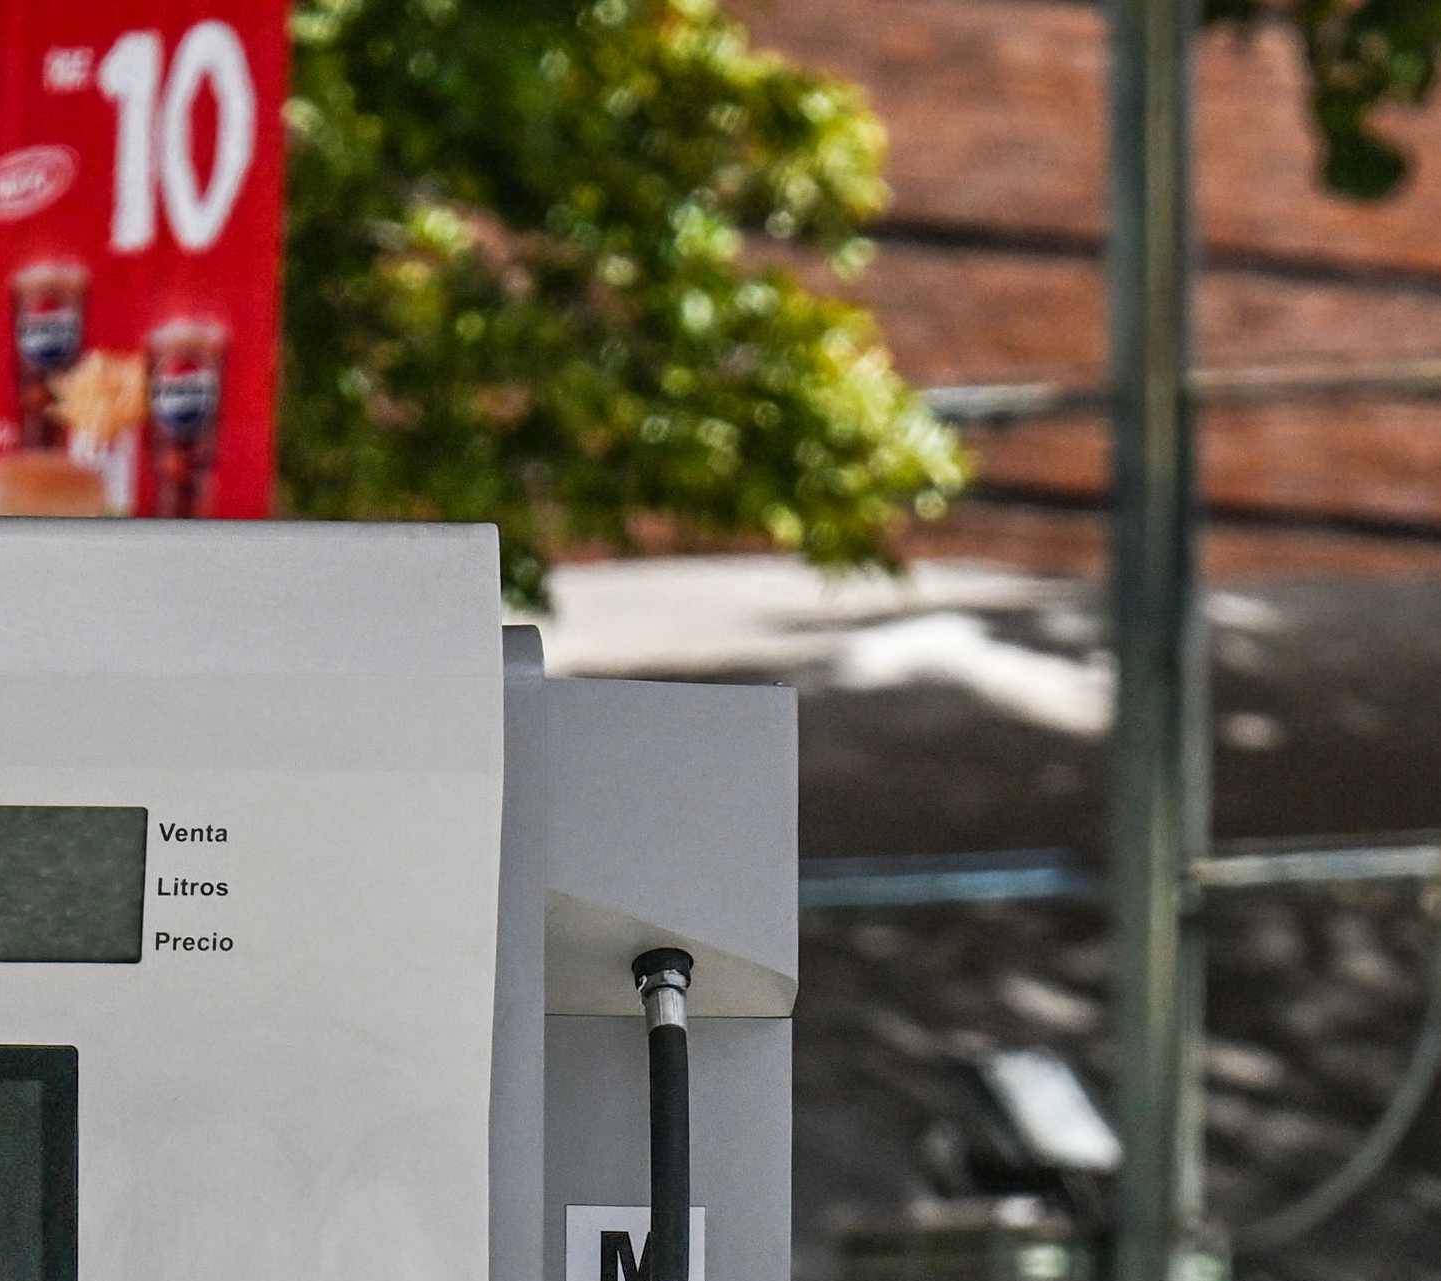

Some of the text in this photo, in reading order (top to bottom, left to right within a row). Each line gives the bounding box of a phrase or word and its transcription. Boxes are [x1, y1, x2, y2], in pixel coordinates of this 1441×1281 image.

[98, 20, 257, 254] 10
[159, 822, 228, 843] Venta
[157, 877, 229, 897] Litros
[155, 931, 234, 952] Precio
